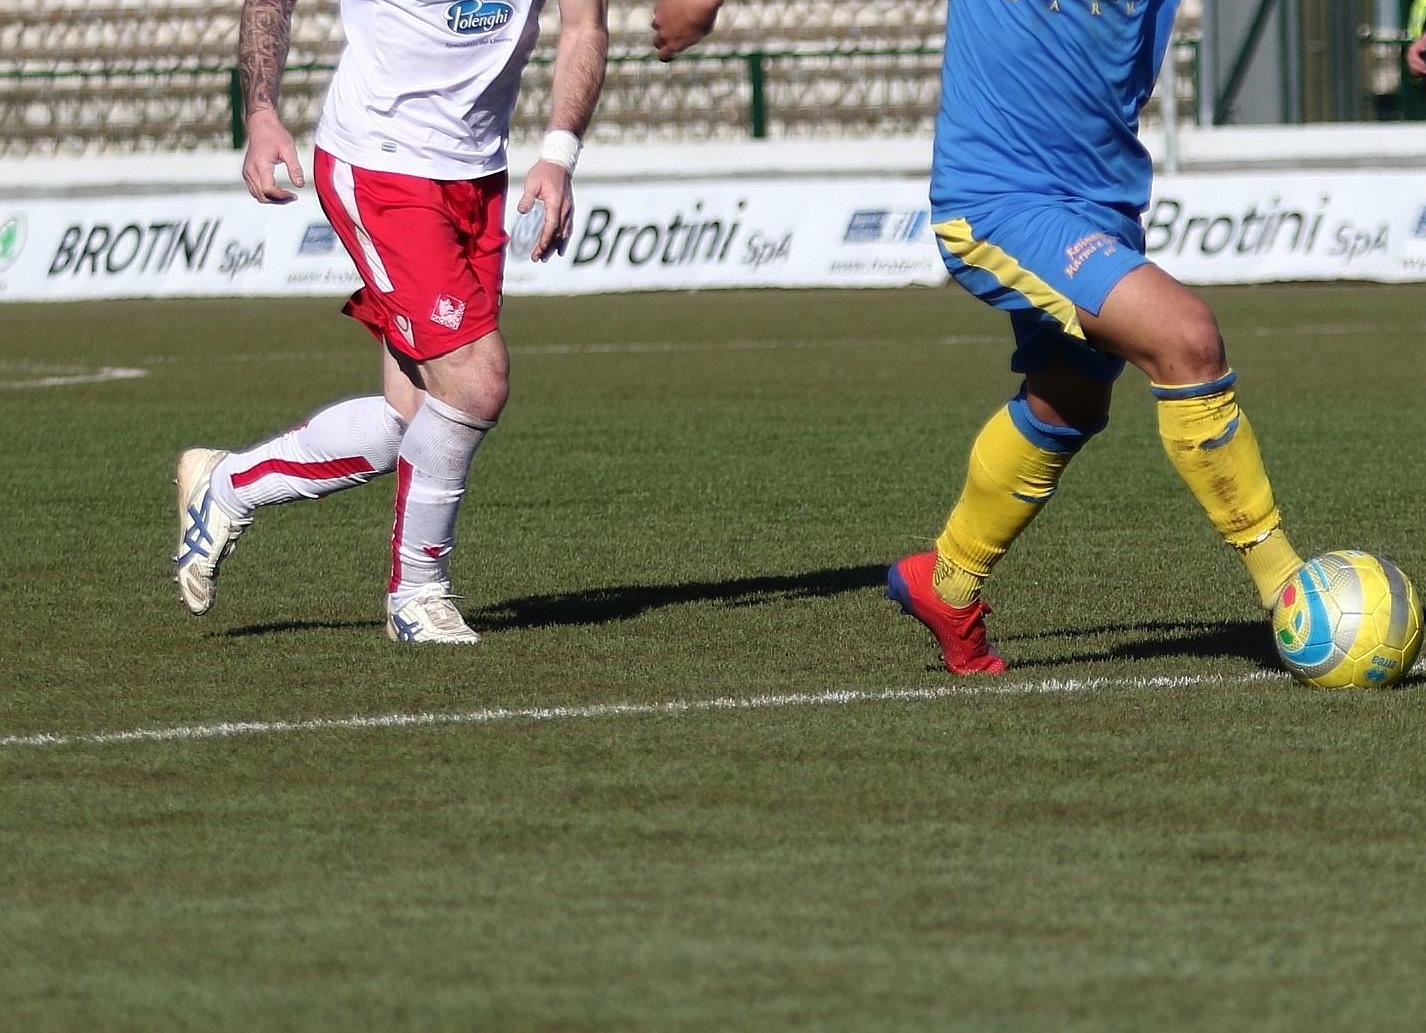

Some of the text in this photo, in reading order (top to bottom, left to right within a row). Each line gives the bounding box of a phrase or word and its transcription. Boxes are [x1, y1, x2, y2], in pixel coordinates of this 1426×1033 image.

[47, 217, 267, 281] BROTINI SpA
[570, 199, 794, 270] Brotini SpA
[1144, 192, 1331, 259] Brotini
[1329, 218, 1388, 261] SpA
